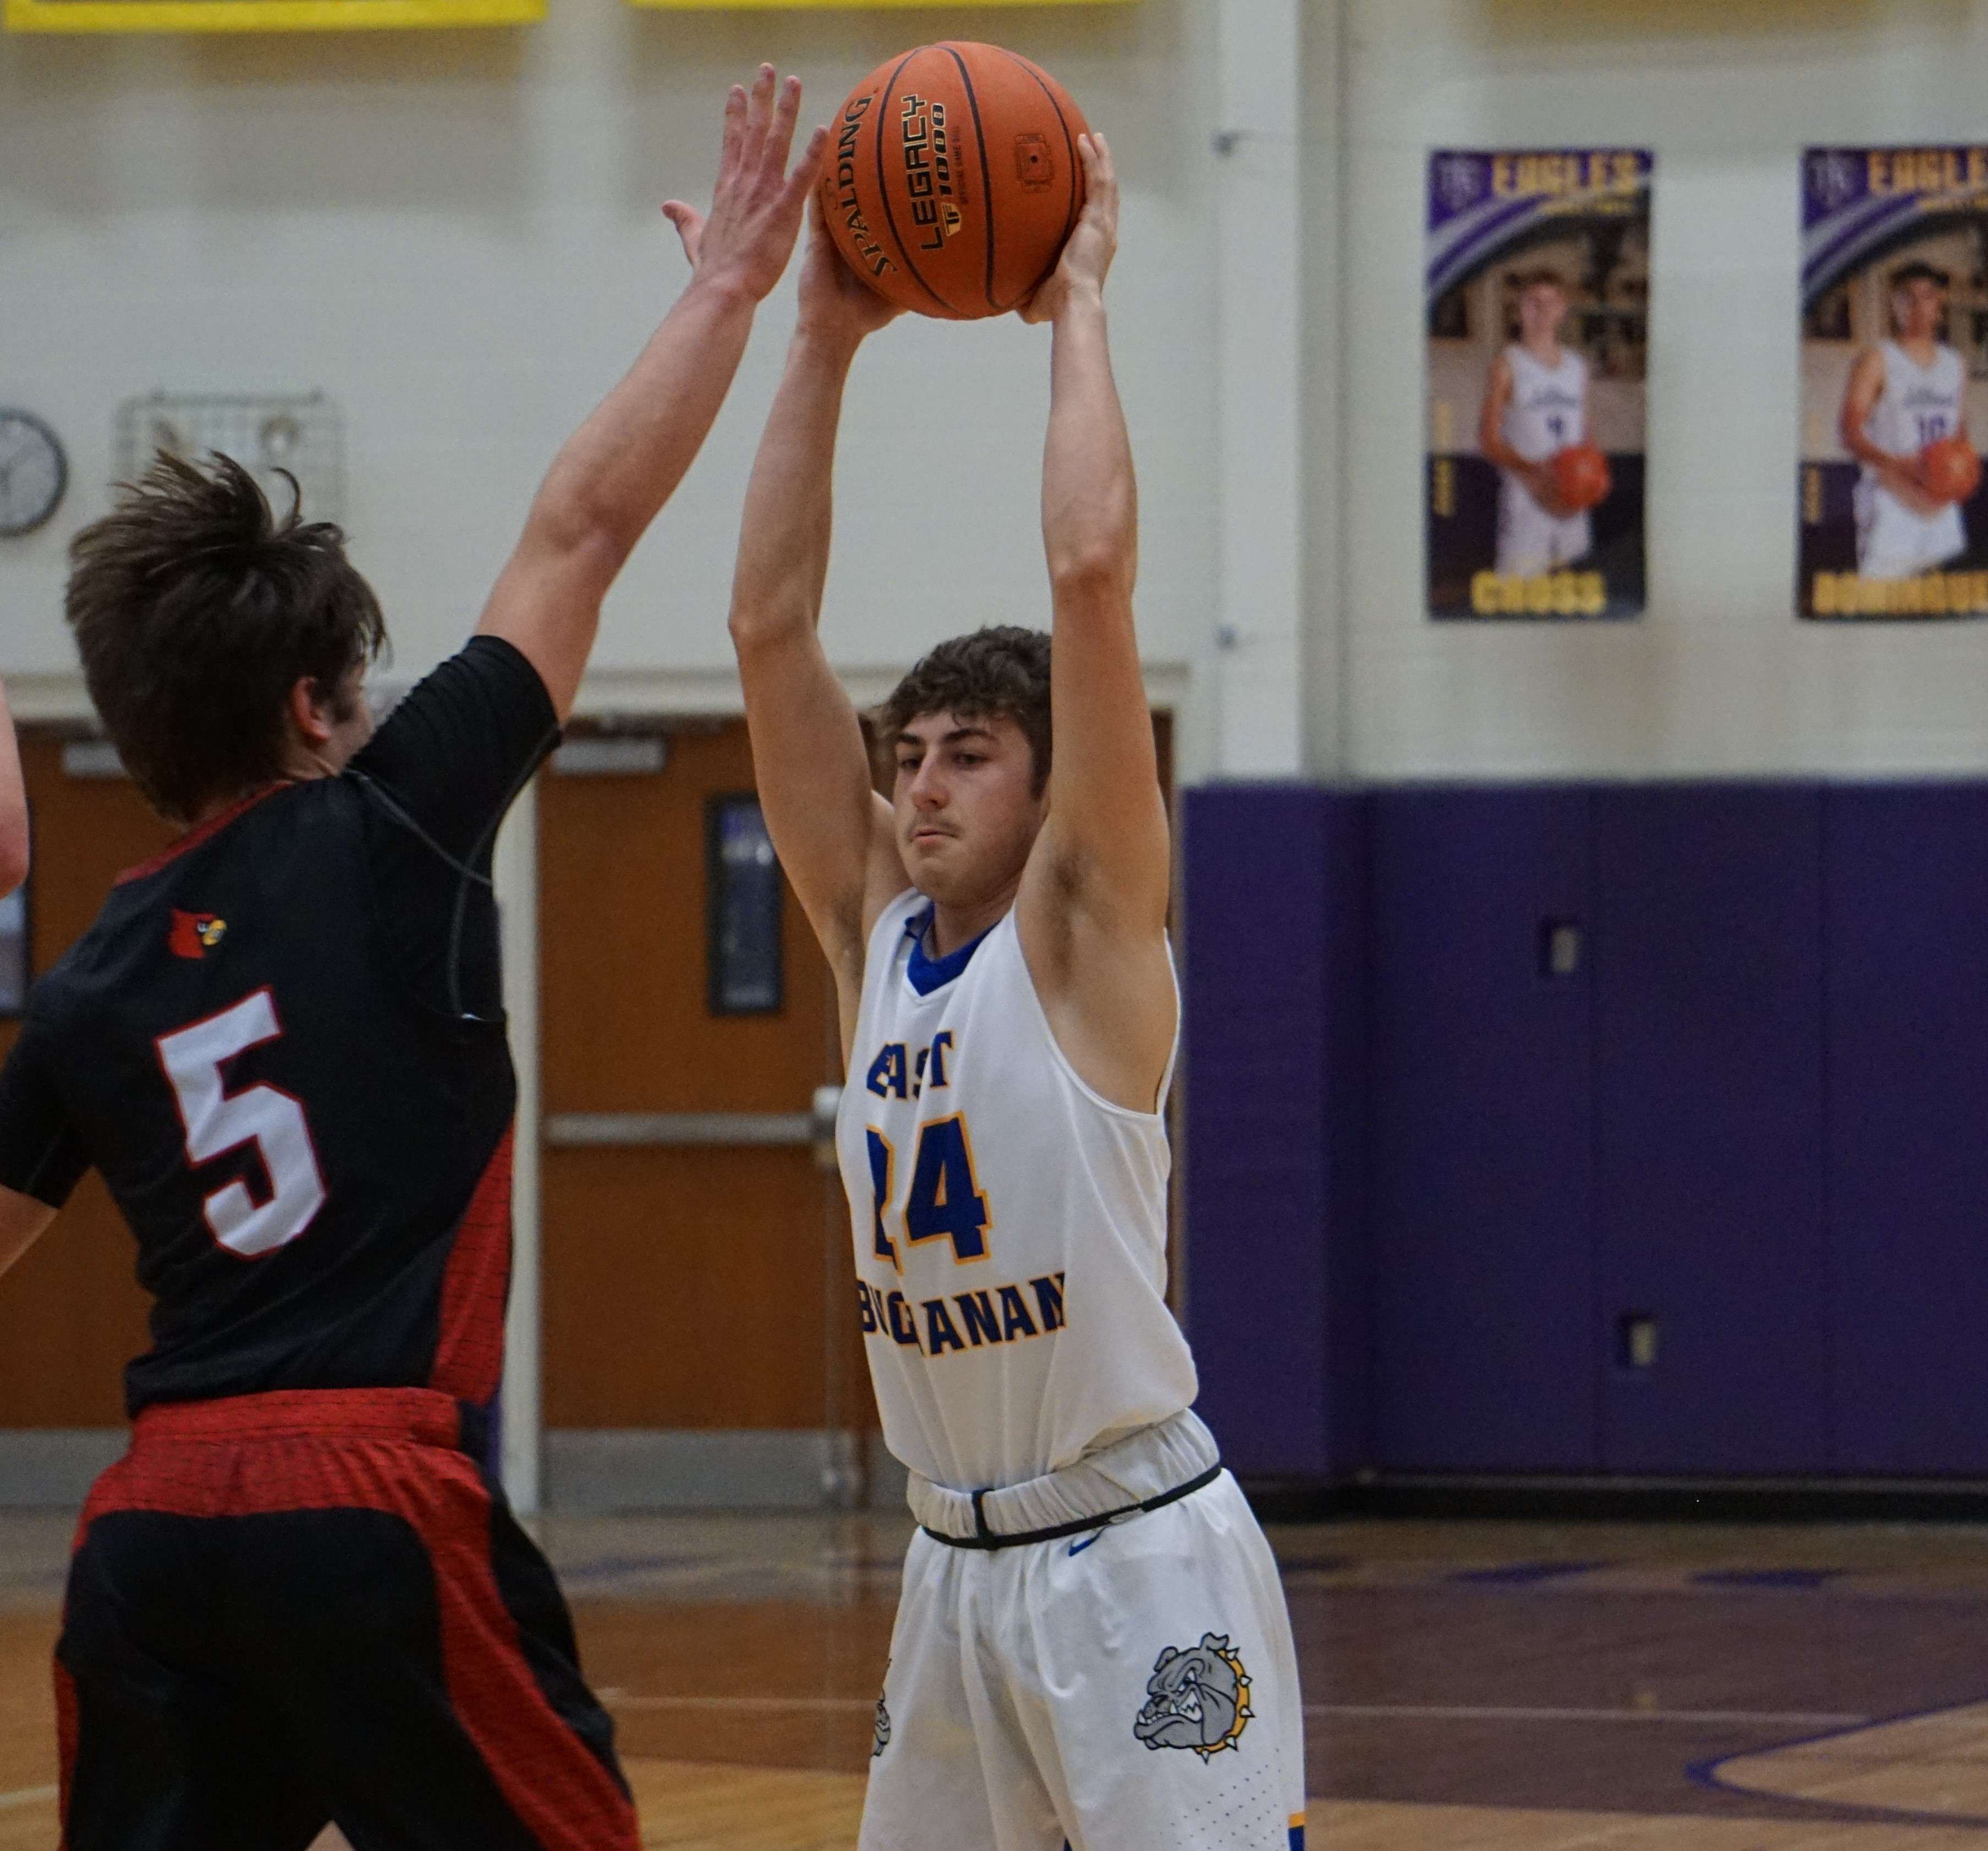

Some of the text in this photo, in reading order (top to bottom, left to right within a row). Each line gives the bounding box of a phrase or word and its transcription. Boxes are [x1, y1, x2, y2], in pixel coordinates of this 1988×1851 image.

[838, 95, 898, 277] SPALDING
[901, 94, 944, 250] LEGACY
[931, 102, 953, 197] 1000
[1492, 152, 1638, 196] EAGLES
[152, 984, 328, 1262] 5
[857, 1271, 1067, 1357] BCANAN
